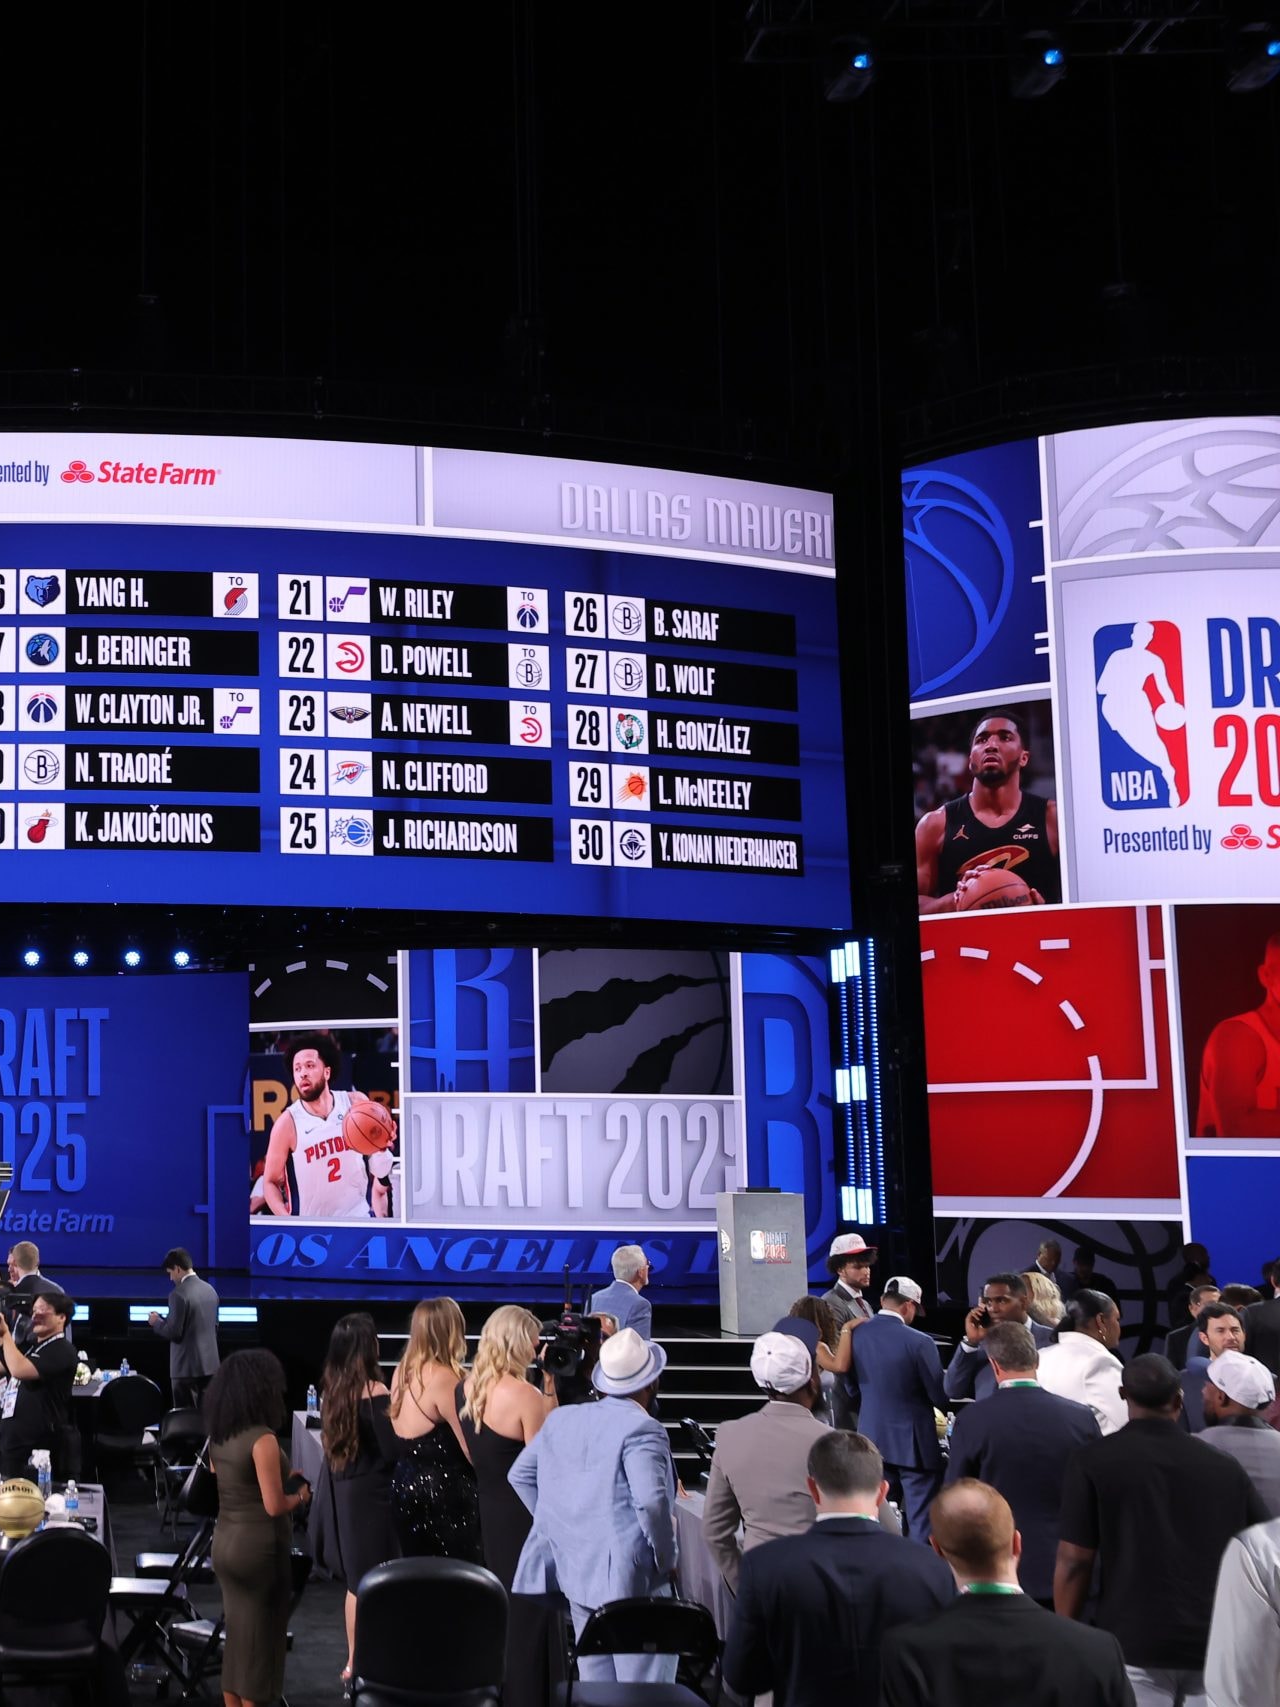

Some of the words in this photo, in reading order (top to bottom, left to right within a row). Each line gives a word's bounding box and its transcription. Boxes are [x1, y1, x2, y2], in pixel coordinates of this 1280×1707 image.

[34, 461, 50, 486] by
[561, 481, 692, 540] DALLAS
[75, 577, 126, 608] YANG
[130, 577, 149, 608] H.
[228, 576, 243, 586] TO
[289, 579, 311, 616] 21
[378, 586, 401, 617] W.
[404, 587, 455, 620] RILEY
[520, 591, 535, 602] TO
[573, 596, 598, 633] 26
[653, 606, 669, 637] B.
[671, 608, 720, 642] SARAF
[622, 607, 632, 630] B
[75, 635, 93, 666] J.
[97, 635, 191, 667] BERINGER
[288, 636, 315, 674] 22
[380, 643, 399, 675] D.
[402, 645, 473, 678] POWELL
[522, 648, 536, 658] TO
[525, 663, 534, 683] B
[575, 653, 599, 689] 27
[655, 662, 671, 693] D.
[672, 664, 716, 697] WOLF
[624, 663, 633, 686] B
[74, 693, 95, 724] W.
[98, 693, 175, 725] CLAYTON
[177, 695, 205, 726] JR.
[229, 692, 245, 702] TO
[288, 694, 315, 732] 23
[380, 701, 399, 732] A.
[402, 702, 473, 736] NEWELL
[523, 705, 537, 715] TO
[575, 709, 601, 747] 28
[656, 718, 673, 749] H.
[675, 717, 751, 755] GONZÁLEZ
[36, 755, 48, 779] B
[75, 751, 95, 783] N.
[98, 746, 173, 784] TRAORÉ
[289, 753, 317, 791] 24
[381, 759, 401, 791] N.
[404, 760, 488, 794] CLIFFORD
[577, 766, 602, 804] 29
[657, 775, 673, 805] L.
[674, 776, 752, 811] McNEELEY
[1110, 769, 1158, 802] NBA
[75, 811, 94, 842] K.
[97, 804, 214, 844] JAKUČIONIS
[289, 811, 317, 850] 25
[382, 818, 400, 849] J.
[403, 818, 518, 854] RICHARDSON
[1012, 833, 1039, 841] CLIFFS
[1103, 824, 1188, 854] Presented
[1192, 824, 1212, 855] by
[578, 823, 604, 861] 30
[659, 831, 671, 862] Y.
[671, 832, 713, 865] KONAN
[714, 835, 798, 870] NIEDERHAUSER
[327, 1157, 342, 1183] 2
[412, 1101, 592, 1208] DRAFT
[605, 1101, 736, 1210] 202
[250, 1232, 332, 1268] OS
